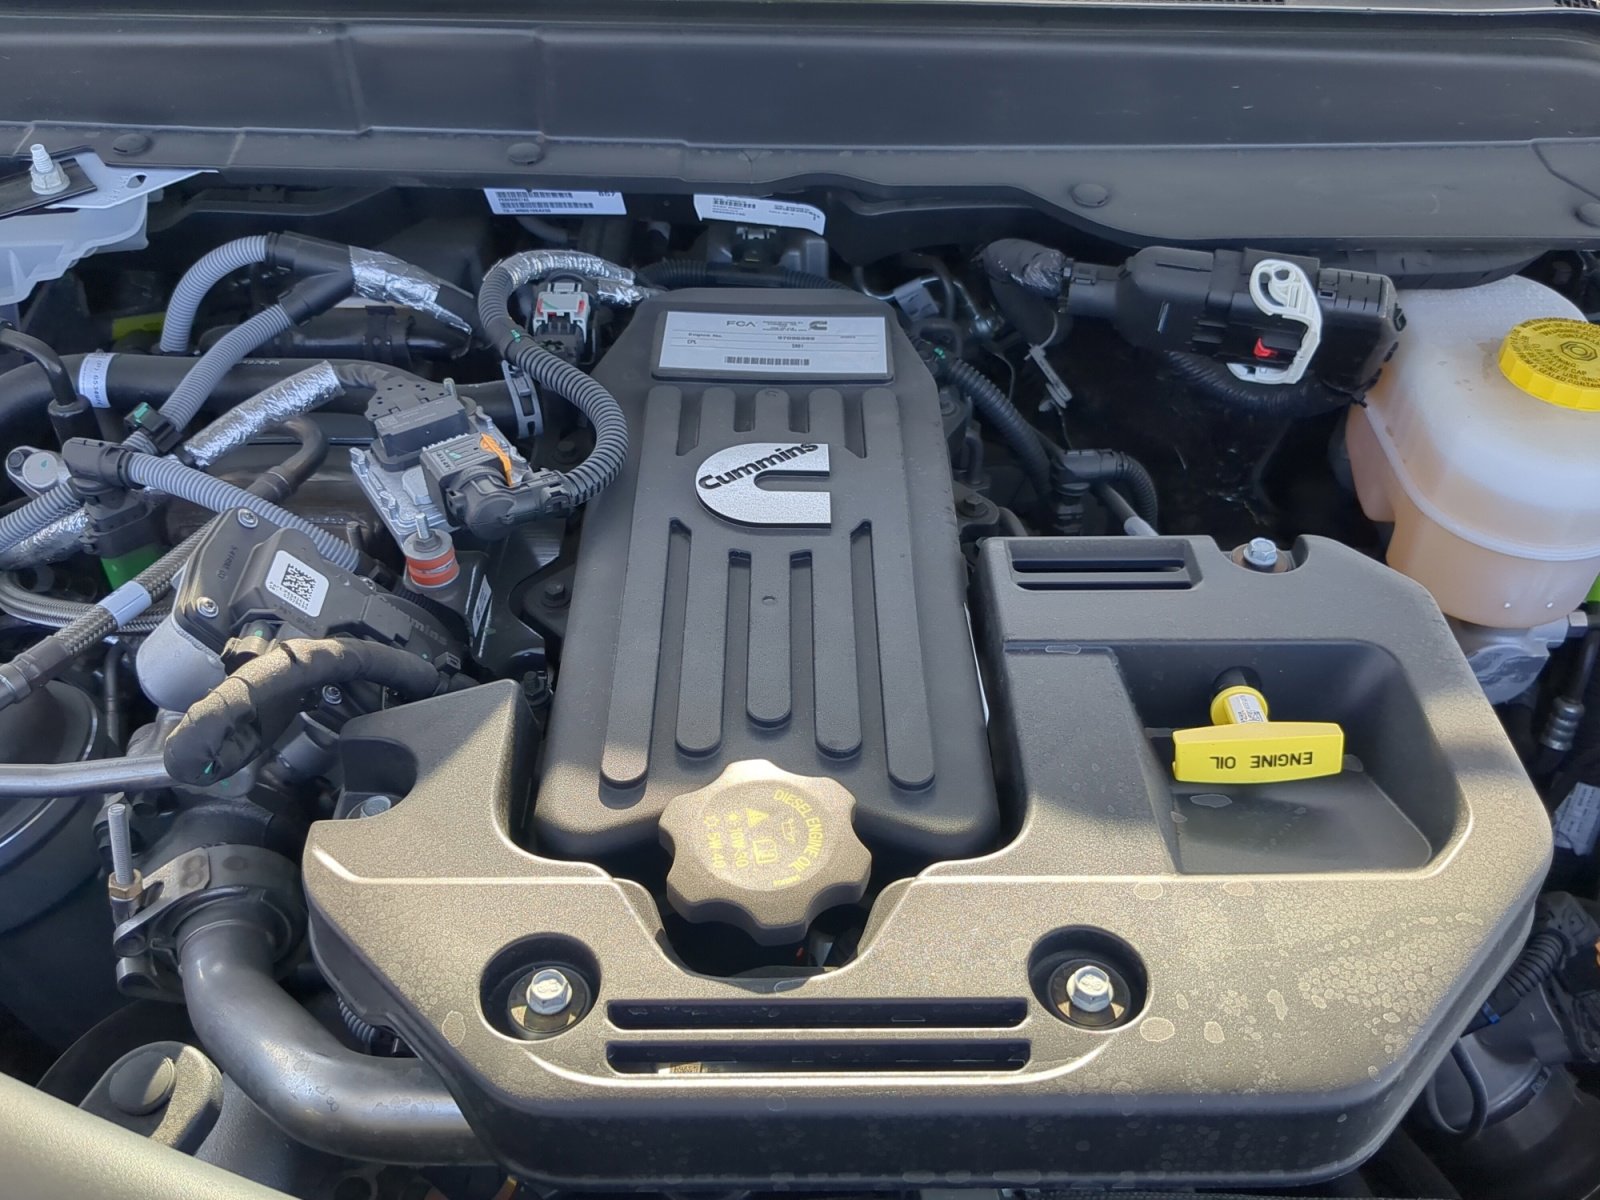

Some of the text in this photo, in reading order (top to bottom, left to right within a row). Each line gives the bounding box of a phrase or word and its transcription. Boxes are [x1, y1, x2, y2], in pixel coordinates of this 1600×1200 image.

[698, 443, 819, 490] Cummins
[1210, 751, 1313, 769] ENGINE OIL
[774, 789, 823, 872] DIESEL ENGINE OIL
